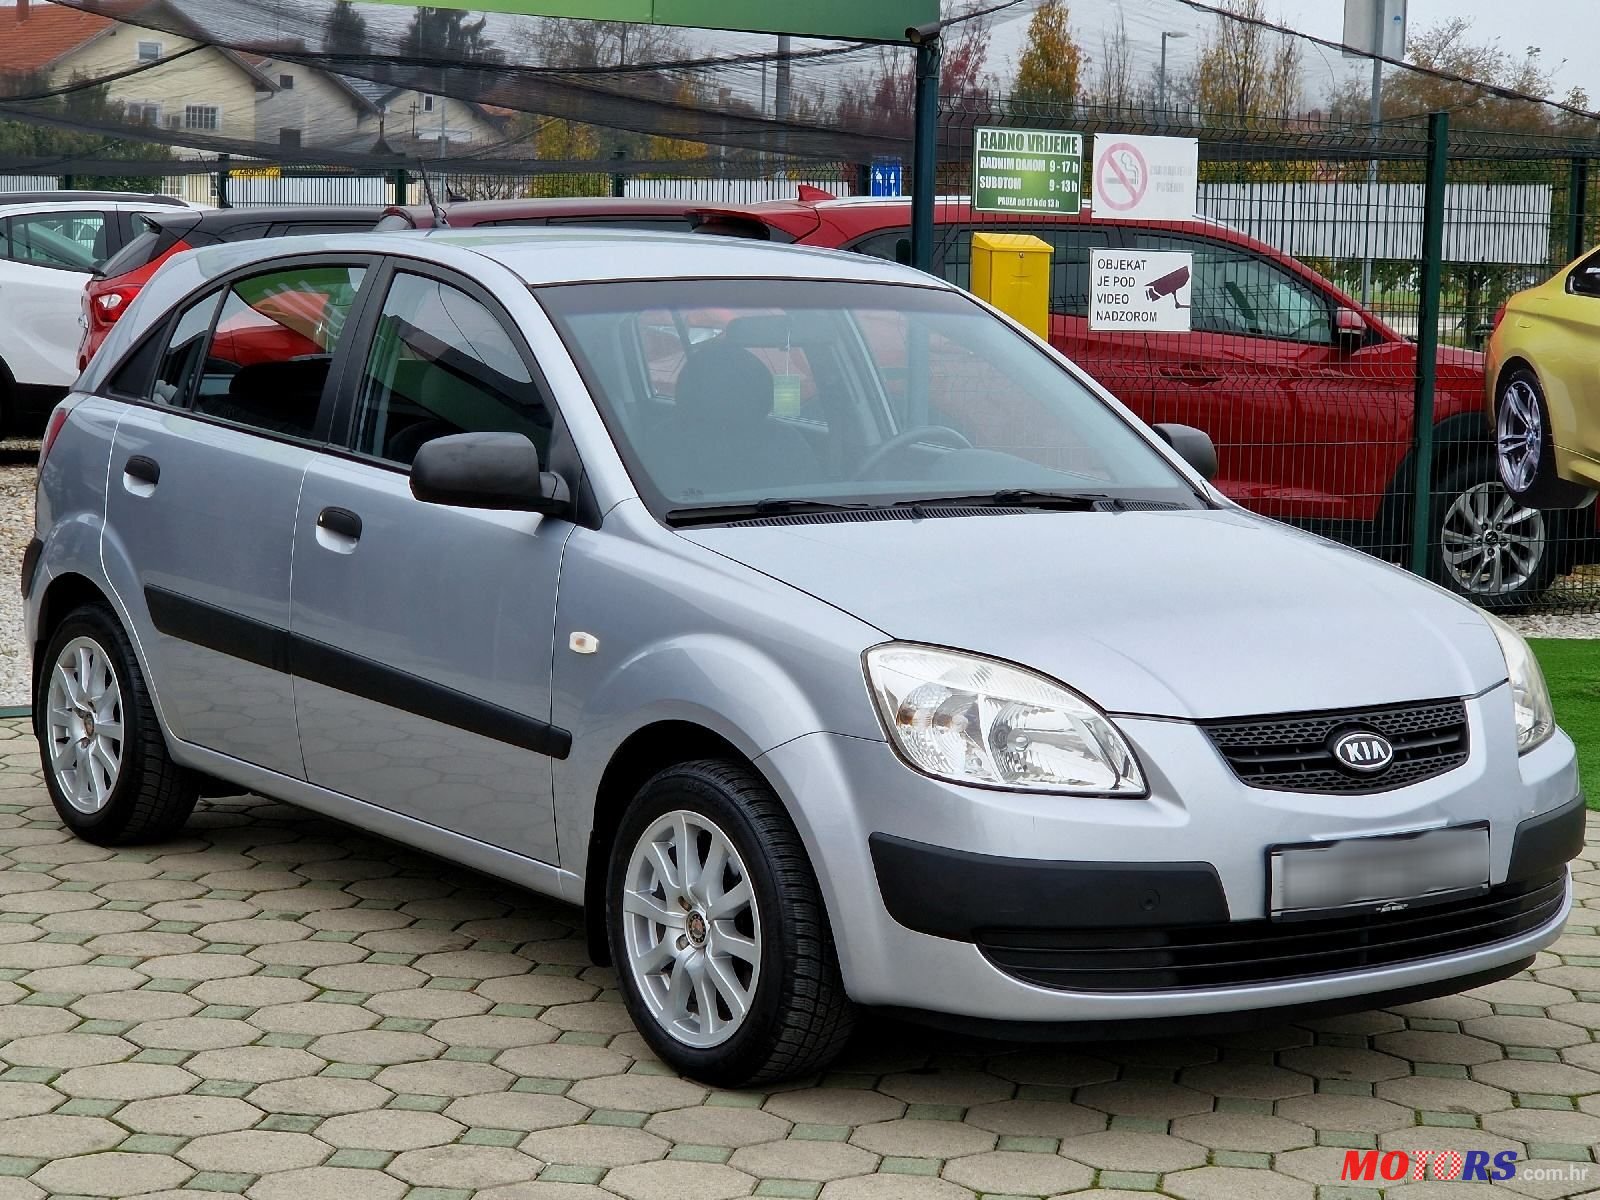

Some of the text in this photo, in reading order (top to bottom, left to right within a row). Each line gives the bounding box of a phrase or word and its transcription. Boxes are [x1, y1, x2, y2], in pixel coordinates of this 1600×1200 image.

[981, 131, 1078, 154] RADNO VRIJEME
[980, 156, 1014, 170] RADNIM
[1049, 160, 1056, 172] 9
[1061, 161, 1070, 173] 17
[1072, 161, 1079, 173] h
[979, 176, 1022, 190] SUBOTOM
[1049, 179, 1055, 191] 9
[1061, 180, 1070, 192] 13
[1072, 180, 1078, 193] h
[998, 196, 1017, 206] PAUZA
[1097, 258, 1147, 271] OBJEKAT
[1097, 275, 1135, 287] JE POD
[1096, 293, 1129, 305] VIDEO
[1096, 310, 1157, 322] NADZOROM
[1345, 741, 1387, 762] KIA
